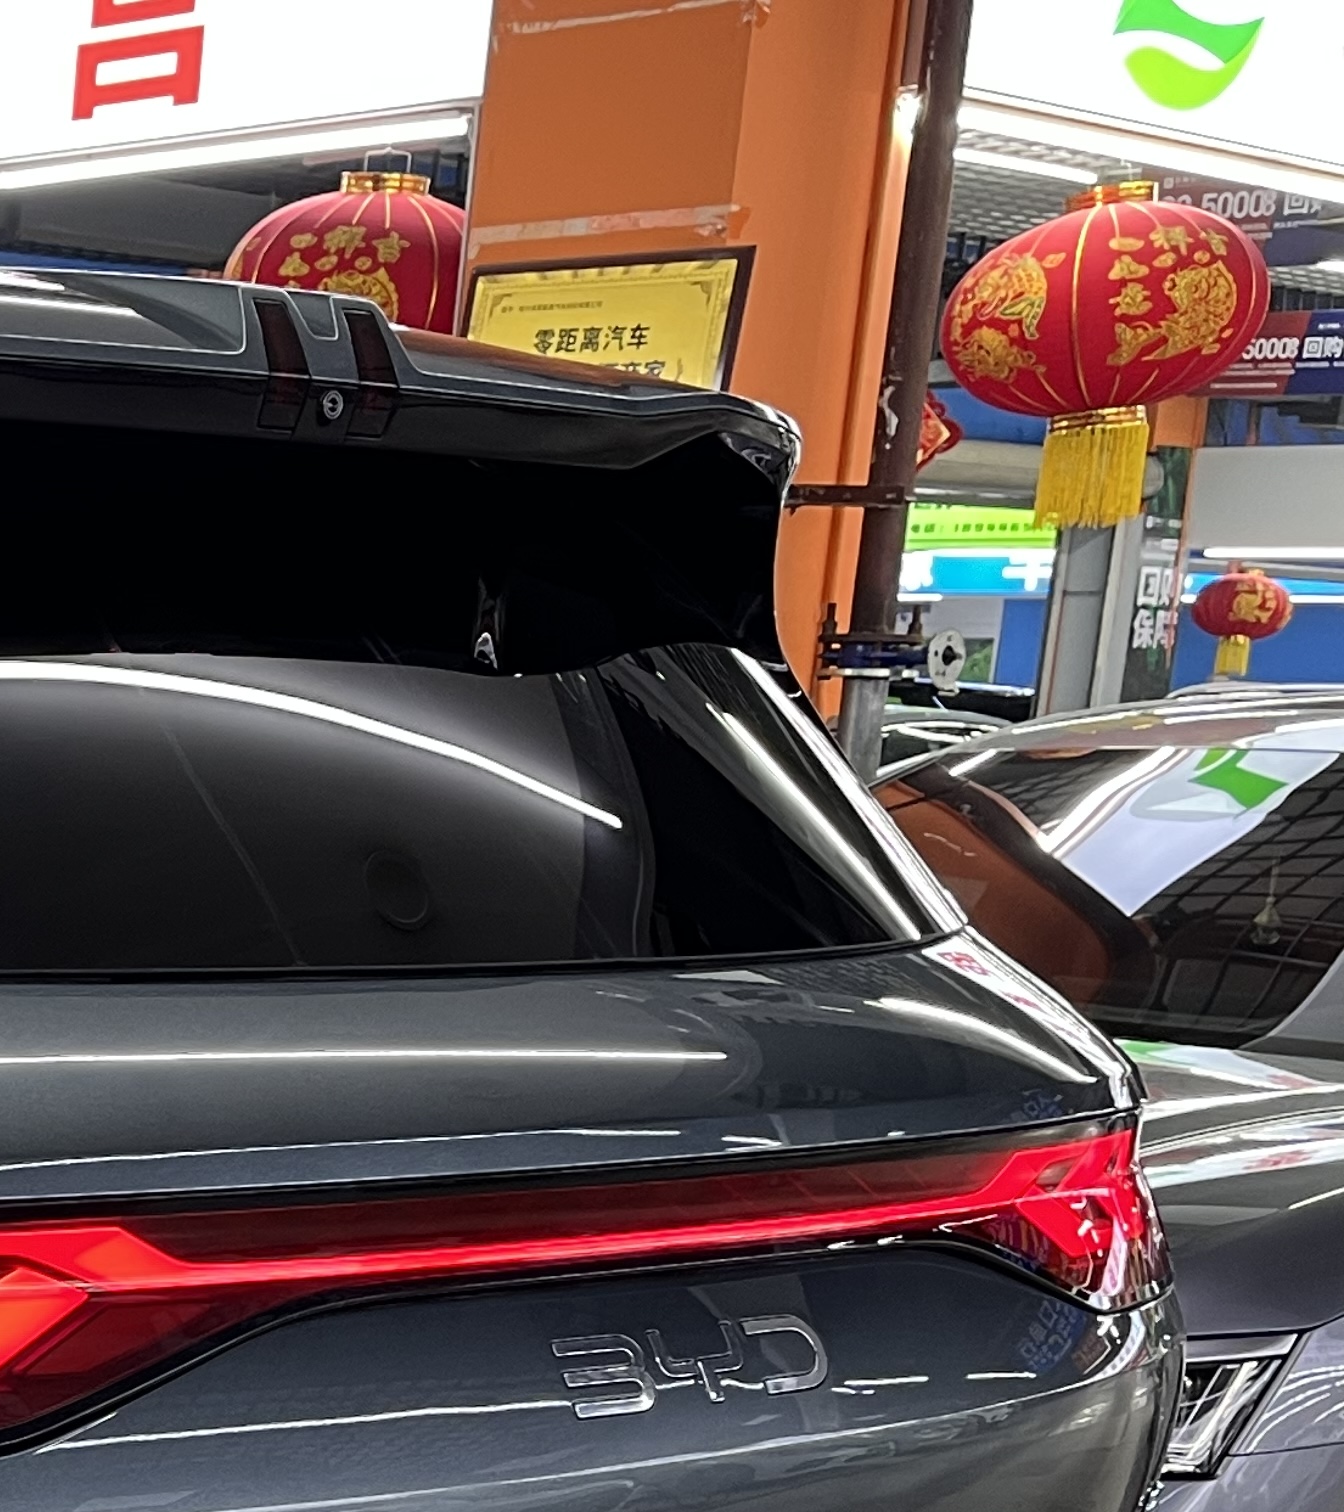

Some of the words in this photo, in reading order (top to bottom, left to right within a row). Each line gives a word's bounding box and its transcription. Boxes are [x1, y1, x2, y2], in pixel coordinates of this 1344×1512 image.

[534, 323, 651, 354] 零距离汽车
[551, 1314, 828, 1420] BYD
